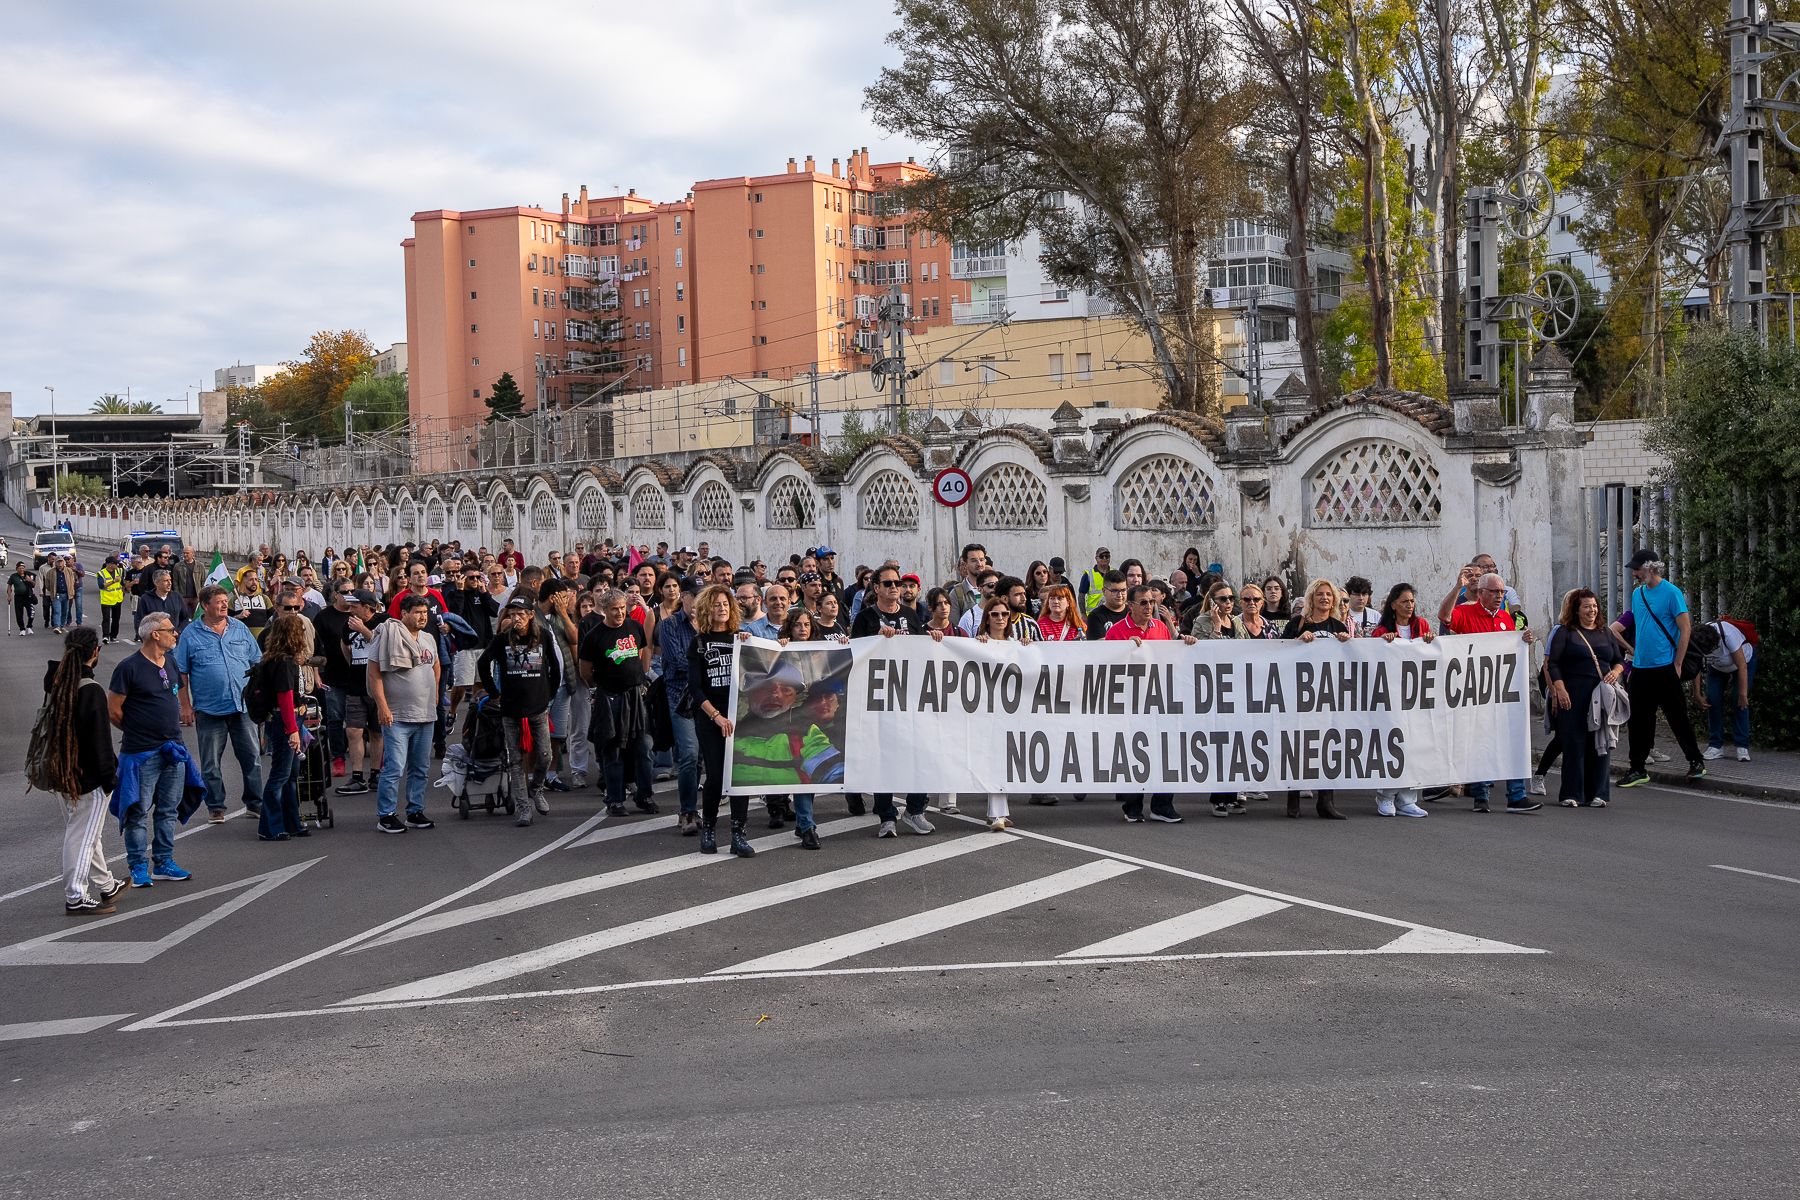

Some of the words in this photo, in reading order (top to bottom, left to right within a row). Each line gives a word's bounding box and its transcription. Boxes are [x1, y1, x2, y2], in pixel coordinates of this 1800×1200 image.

[942, 480, 965, 493] 40
[617, 634, 637, 651] sat
[867, 658, 909, 712] EN
[918, 660, 1023, 715] APOYO
[1031, 664, 1071, 714] AL
[1082, 663, 1184, 715] METAL
[1194, 663, 1235, 715] DE
[1246, 662, 1287, 714] LA
[1296, 661, 1392, 713] BAHIA
[1402, 659, 1437, 711] DE
[1445, 643, 1521, 709] CÁDIZ
[1007, 730, 1050, 784] NO
[1060, 731, 1083, 783] A
[1093, 730, 1151, 784] LAS
[1161, 729, 1270, 784] LISTAS
[1281, 727, 1405, 781] NEGRAS
